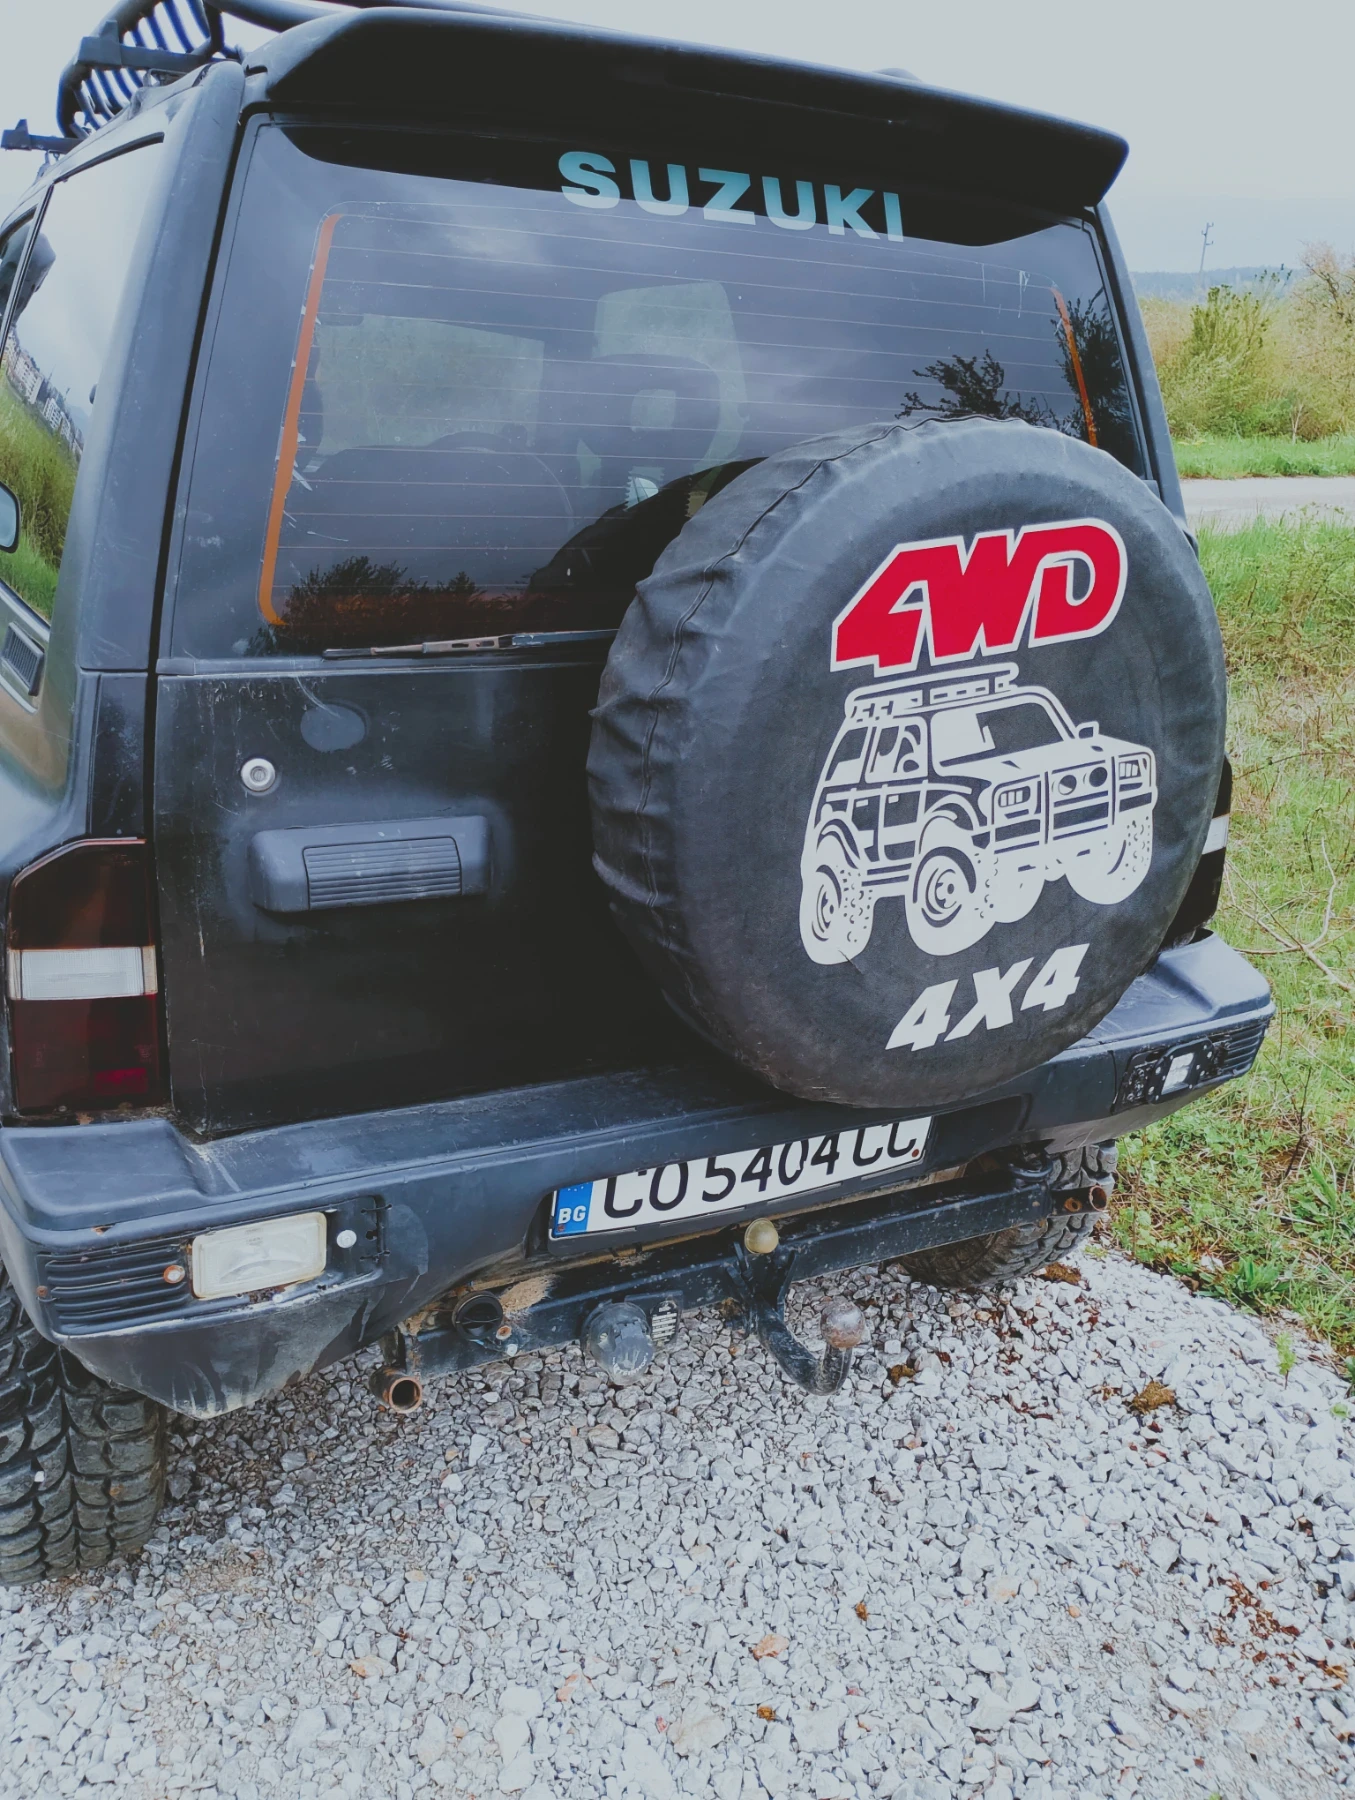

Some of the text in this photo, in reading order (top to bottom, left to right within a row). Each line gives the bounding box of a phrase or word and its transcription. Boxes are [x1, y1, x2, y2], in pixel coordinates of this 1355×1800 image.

[558, 151, 904, 242] SUZUKI
[830, 518, 1128, 677] 4WD
[885, 943, 1090, 1051] 4X4
[558, 1206, 586, 1224] BG
